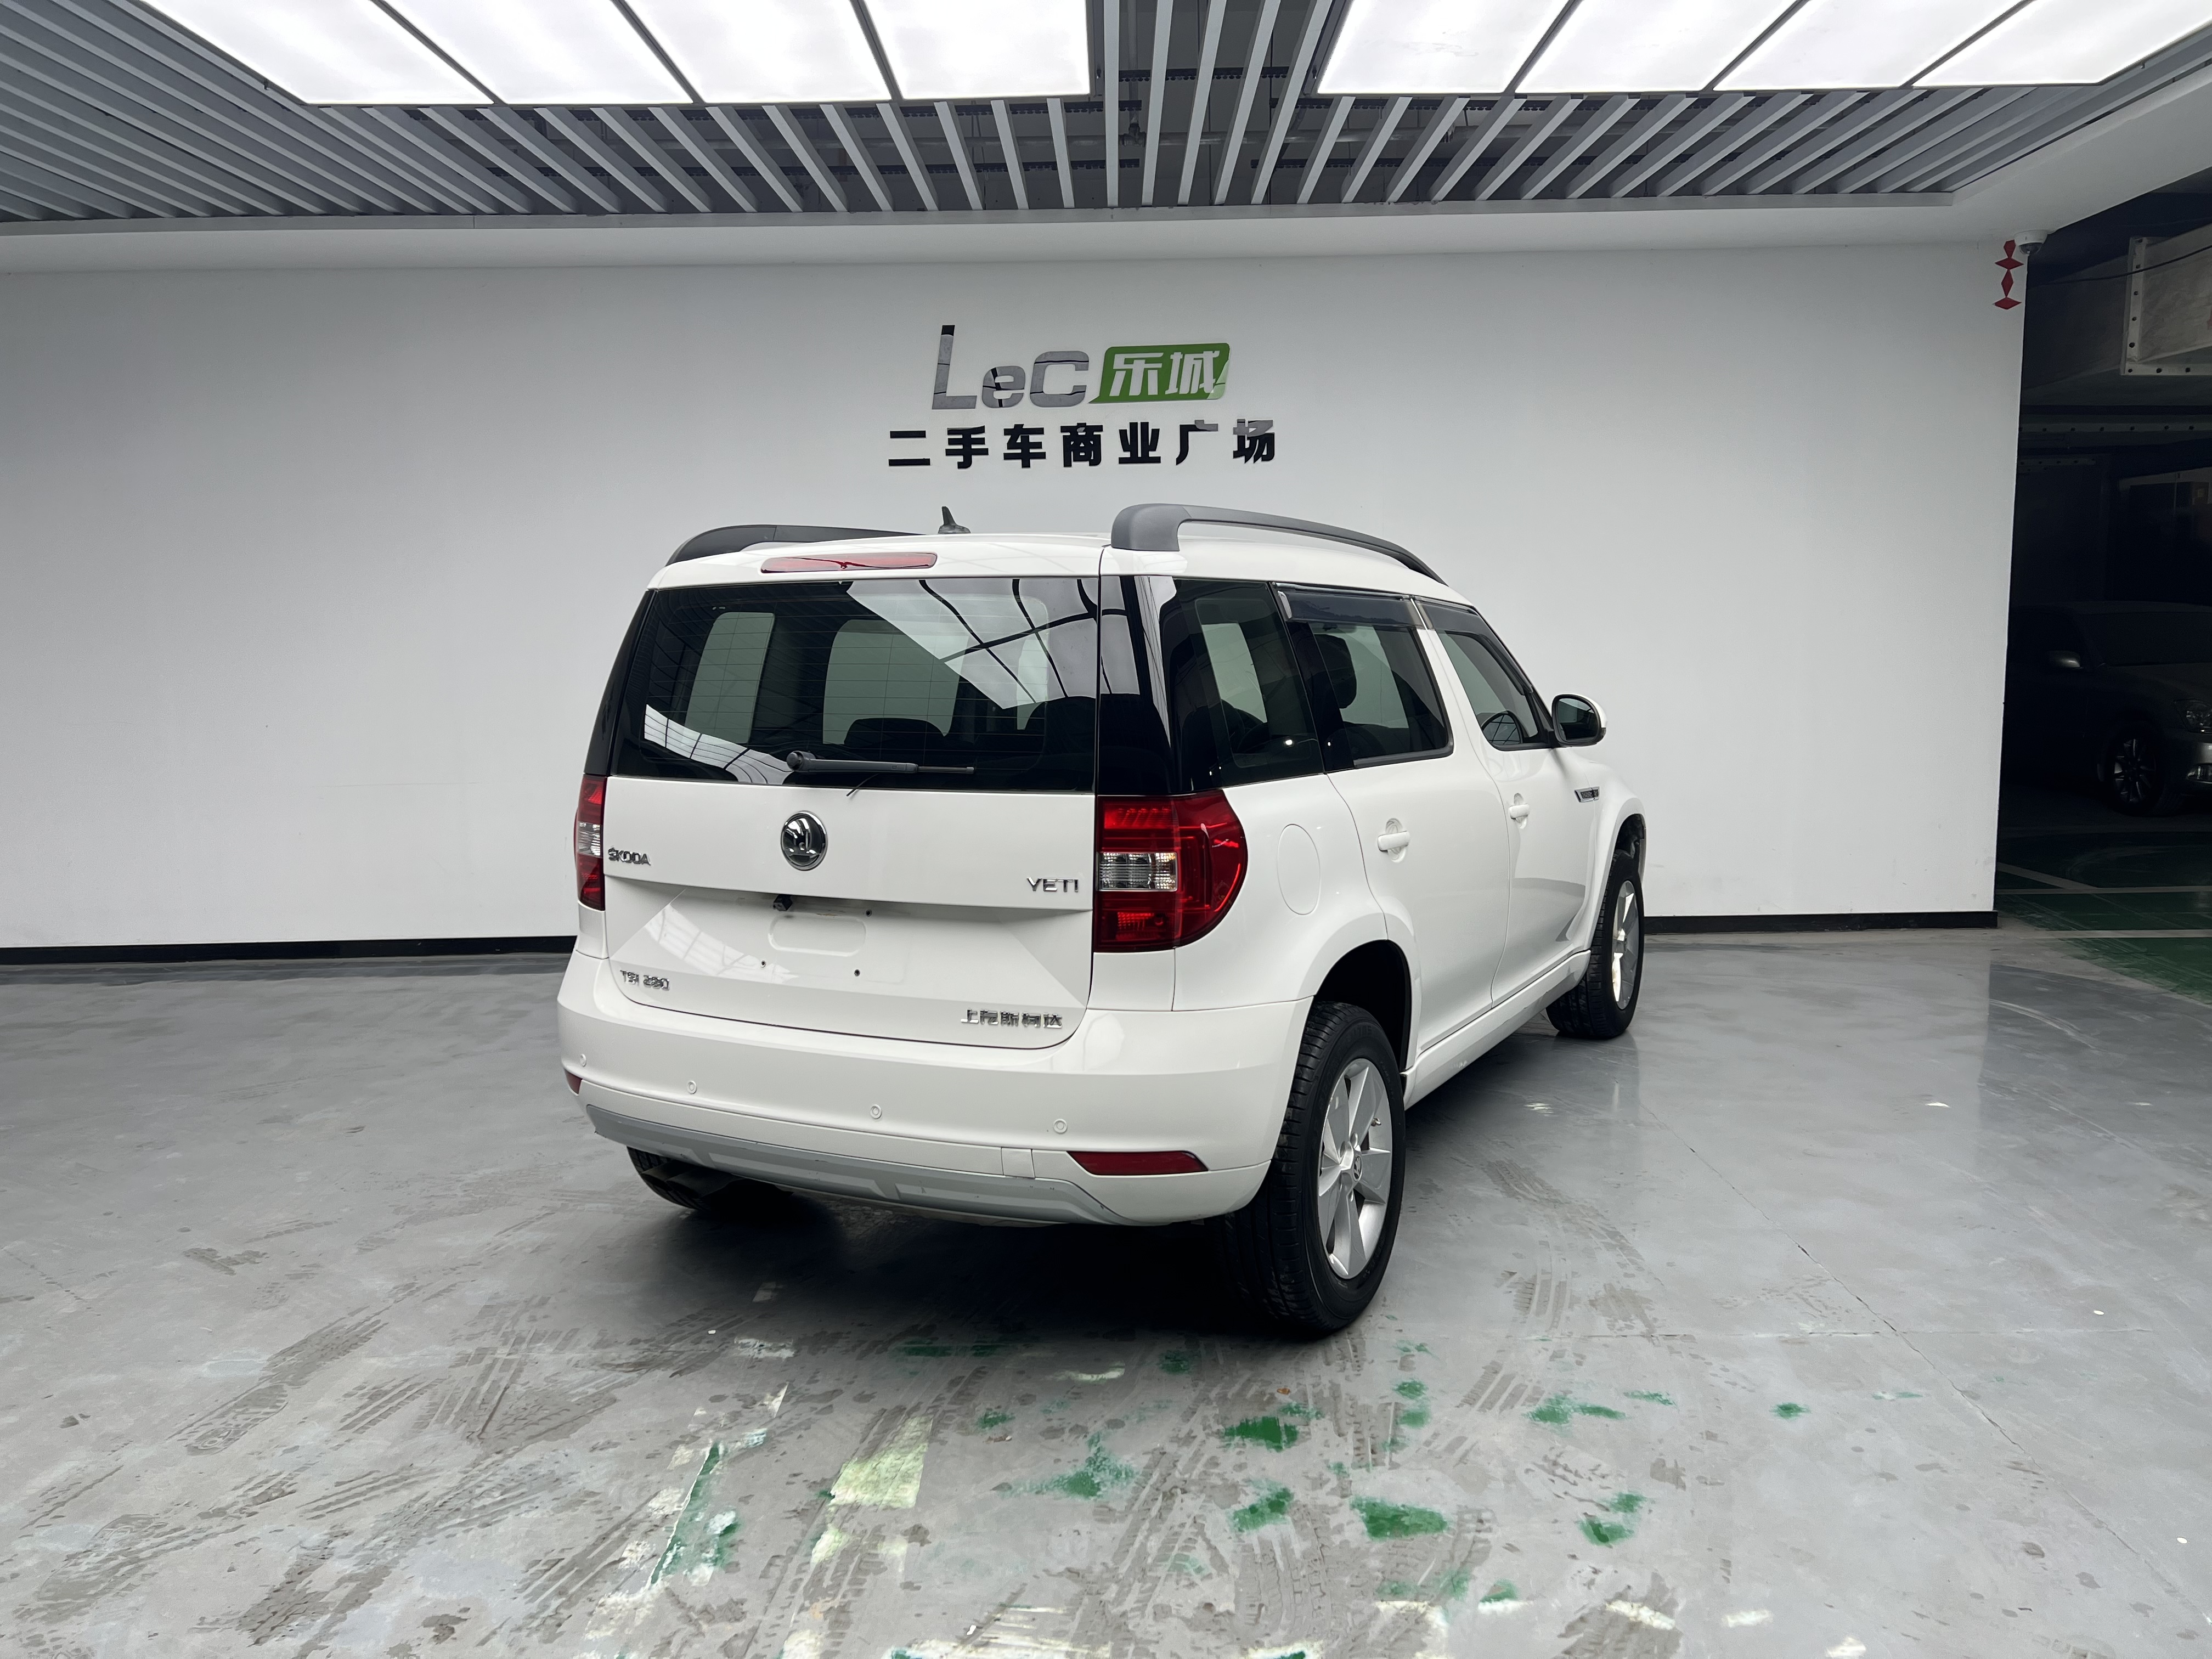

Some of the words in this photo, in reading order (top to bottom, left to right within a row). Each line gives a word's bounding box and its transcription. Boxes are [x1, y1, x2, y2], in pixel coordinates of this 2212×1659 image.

[1109, 350, 1220, 397] 乐城
[889, 419, 1276, 470] 二手车商业广场
[1026, 877, 1079, 893] YETI
[619, 969, 639, 985] TSI
[960, 1008, 1063, 1029] 上汽斯柯达
